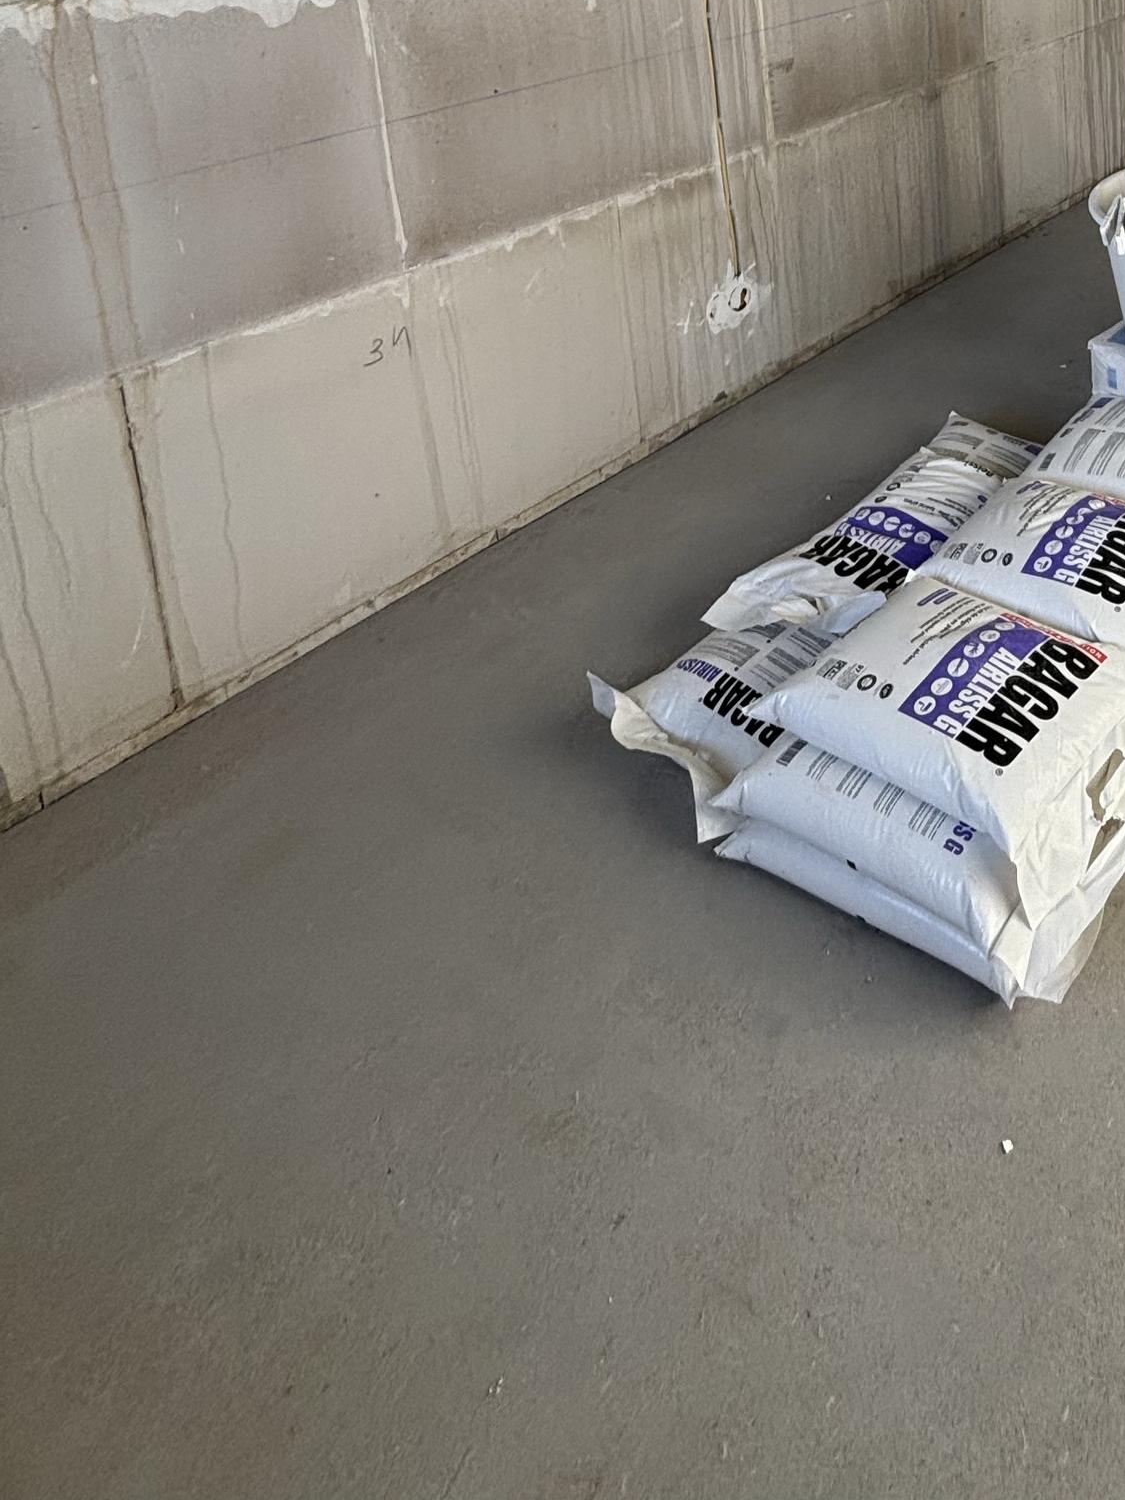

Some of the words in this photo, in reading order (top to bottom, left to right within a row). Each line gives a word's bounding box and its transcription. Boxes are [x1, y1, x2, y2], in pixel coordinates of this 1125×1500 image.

[1062, 515, 1116, 571] AIRLISS
[1053, 567, 1080, 585] G
[948, 646, 1023, 719] AIRLISS
[955, 639, 1100, 767] BAGAR
[933, 714, 963, 737] G
